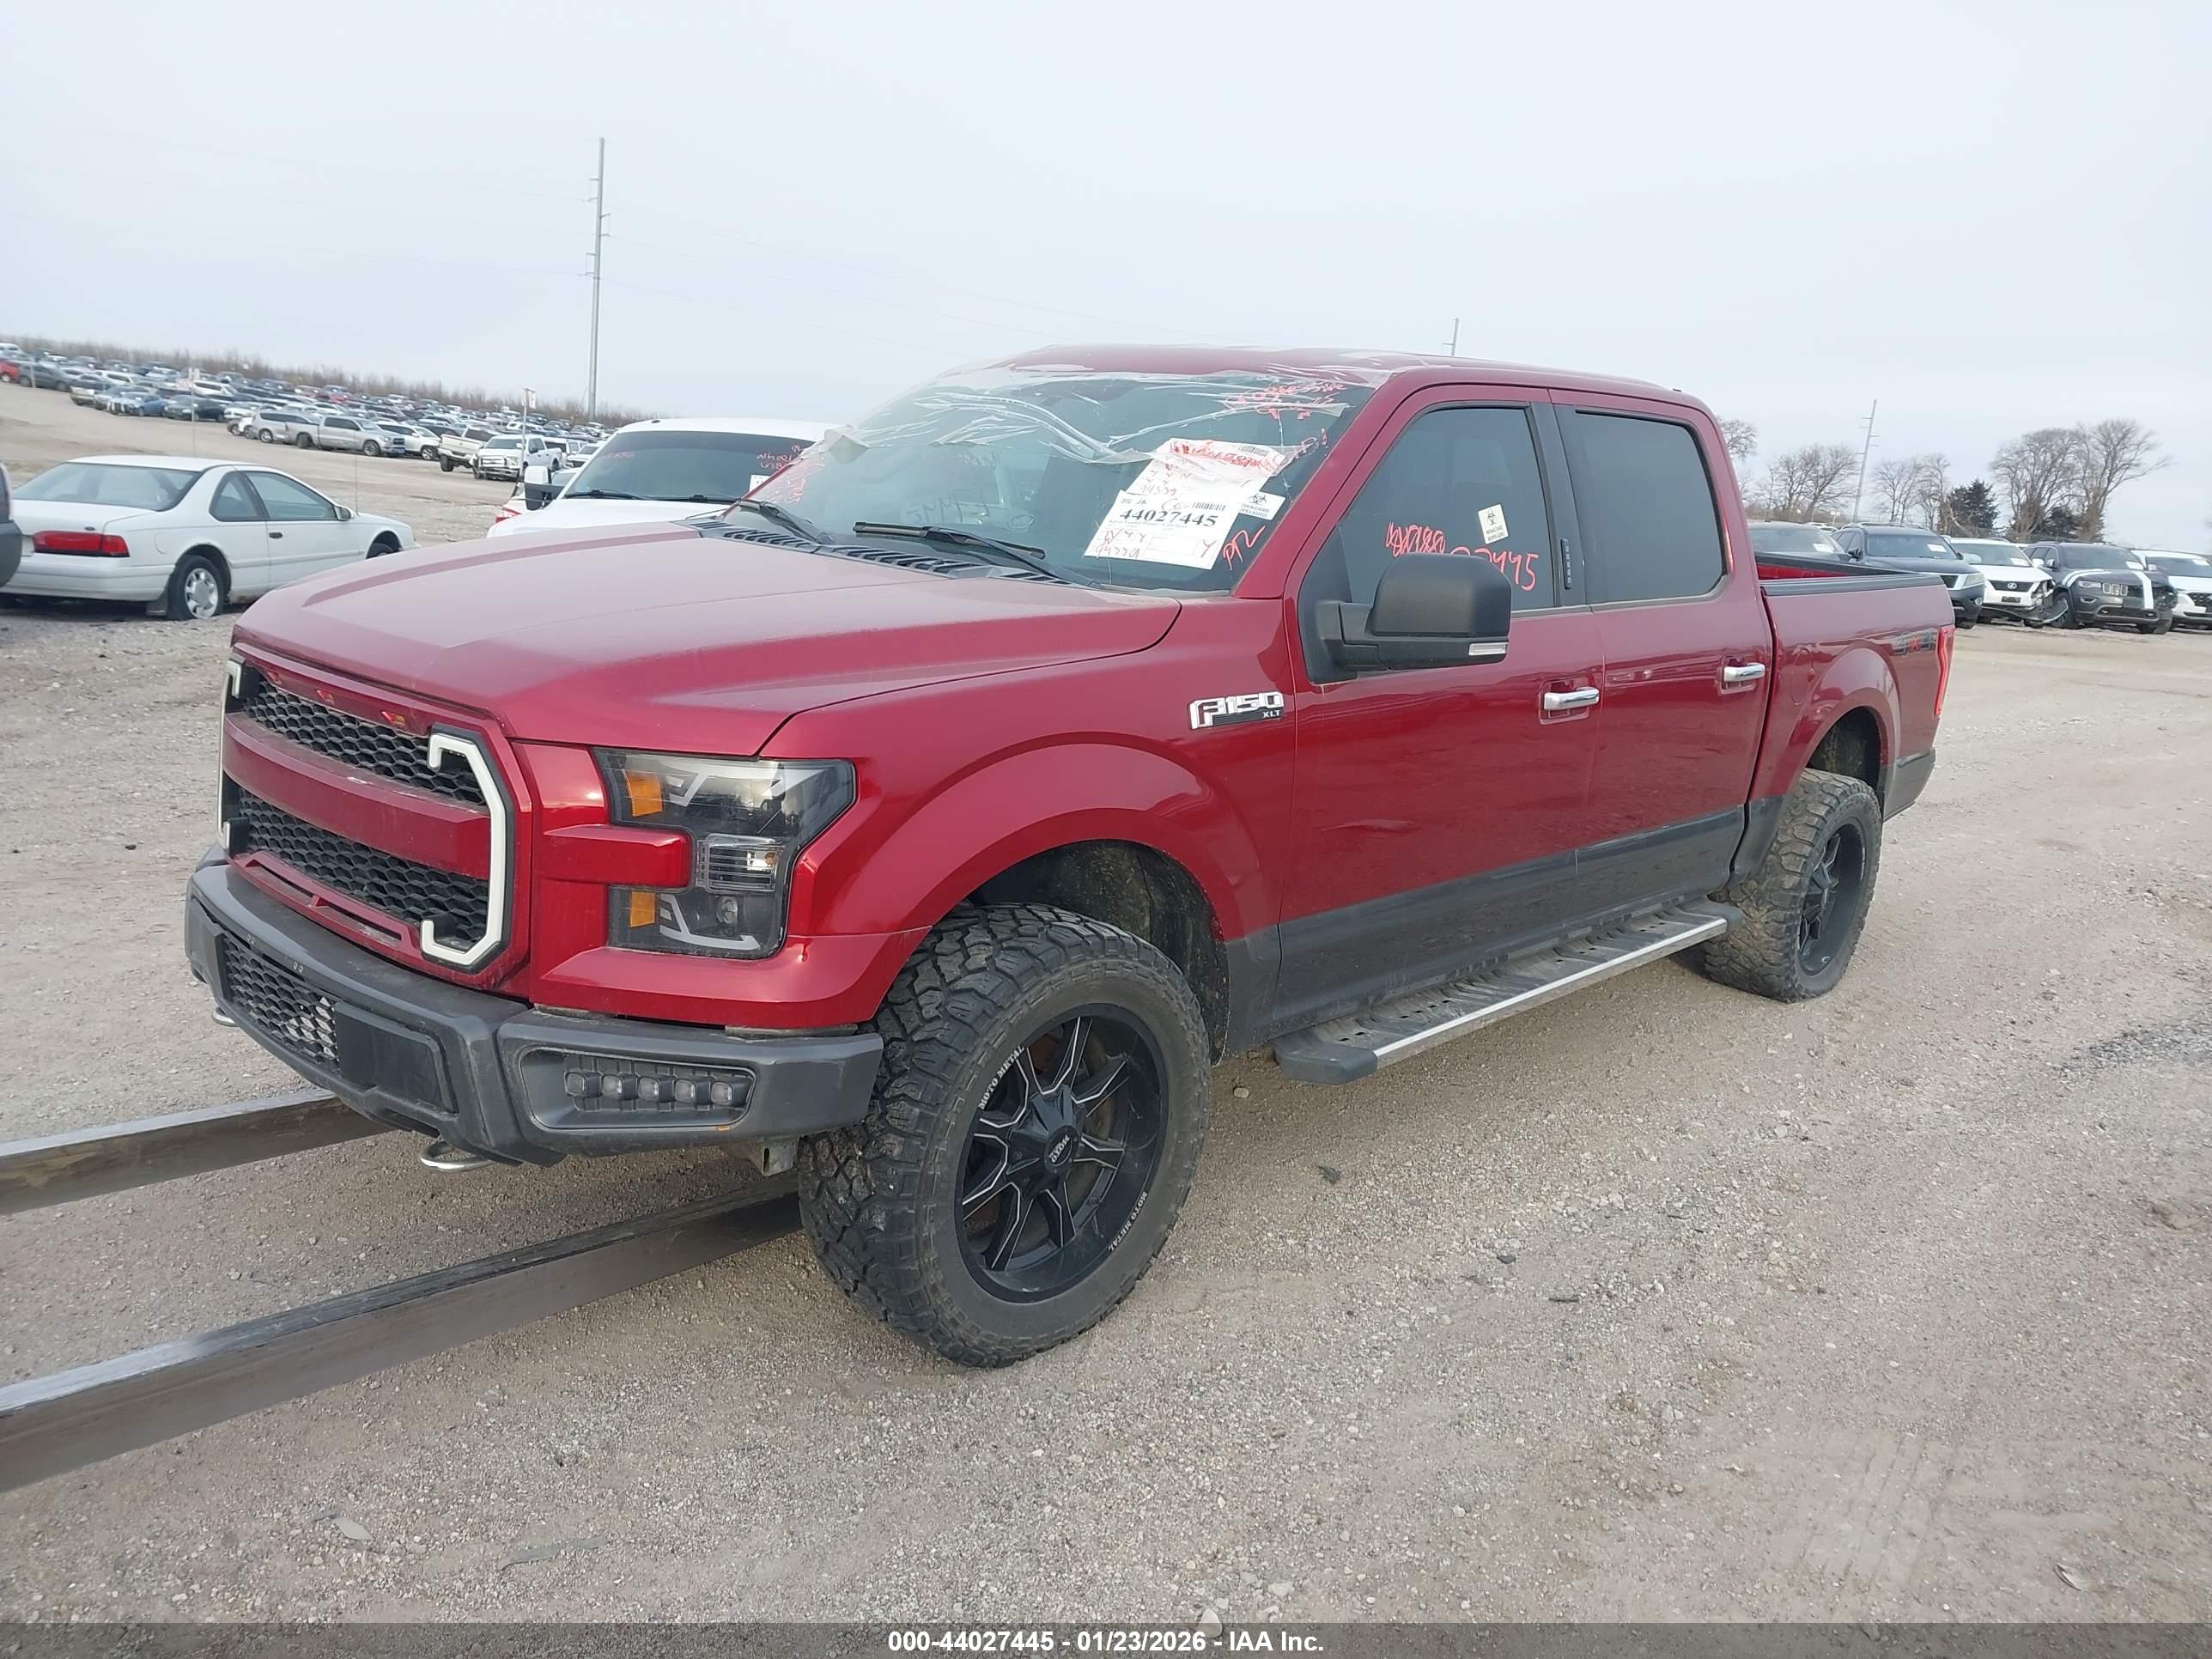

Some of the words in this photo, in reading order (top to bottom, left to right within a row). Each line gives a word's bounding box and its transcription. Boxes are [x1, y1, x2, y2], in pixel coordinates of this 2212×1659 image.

[1120, 508, 1218, 527] 44027445
[1263, 709, 1281, 719] XLT
[977, 1078, 999, 1110] MOTO
[996, 1045, 1025, 1079] METAL
[1131, 1191, 1148, 1220] MOTO
[1108, 1219, 1132, 1251] METAL
